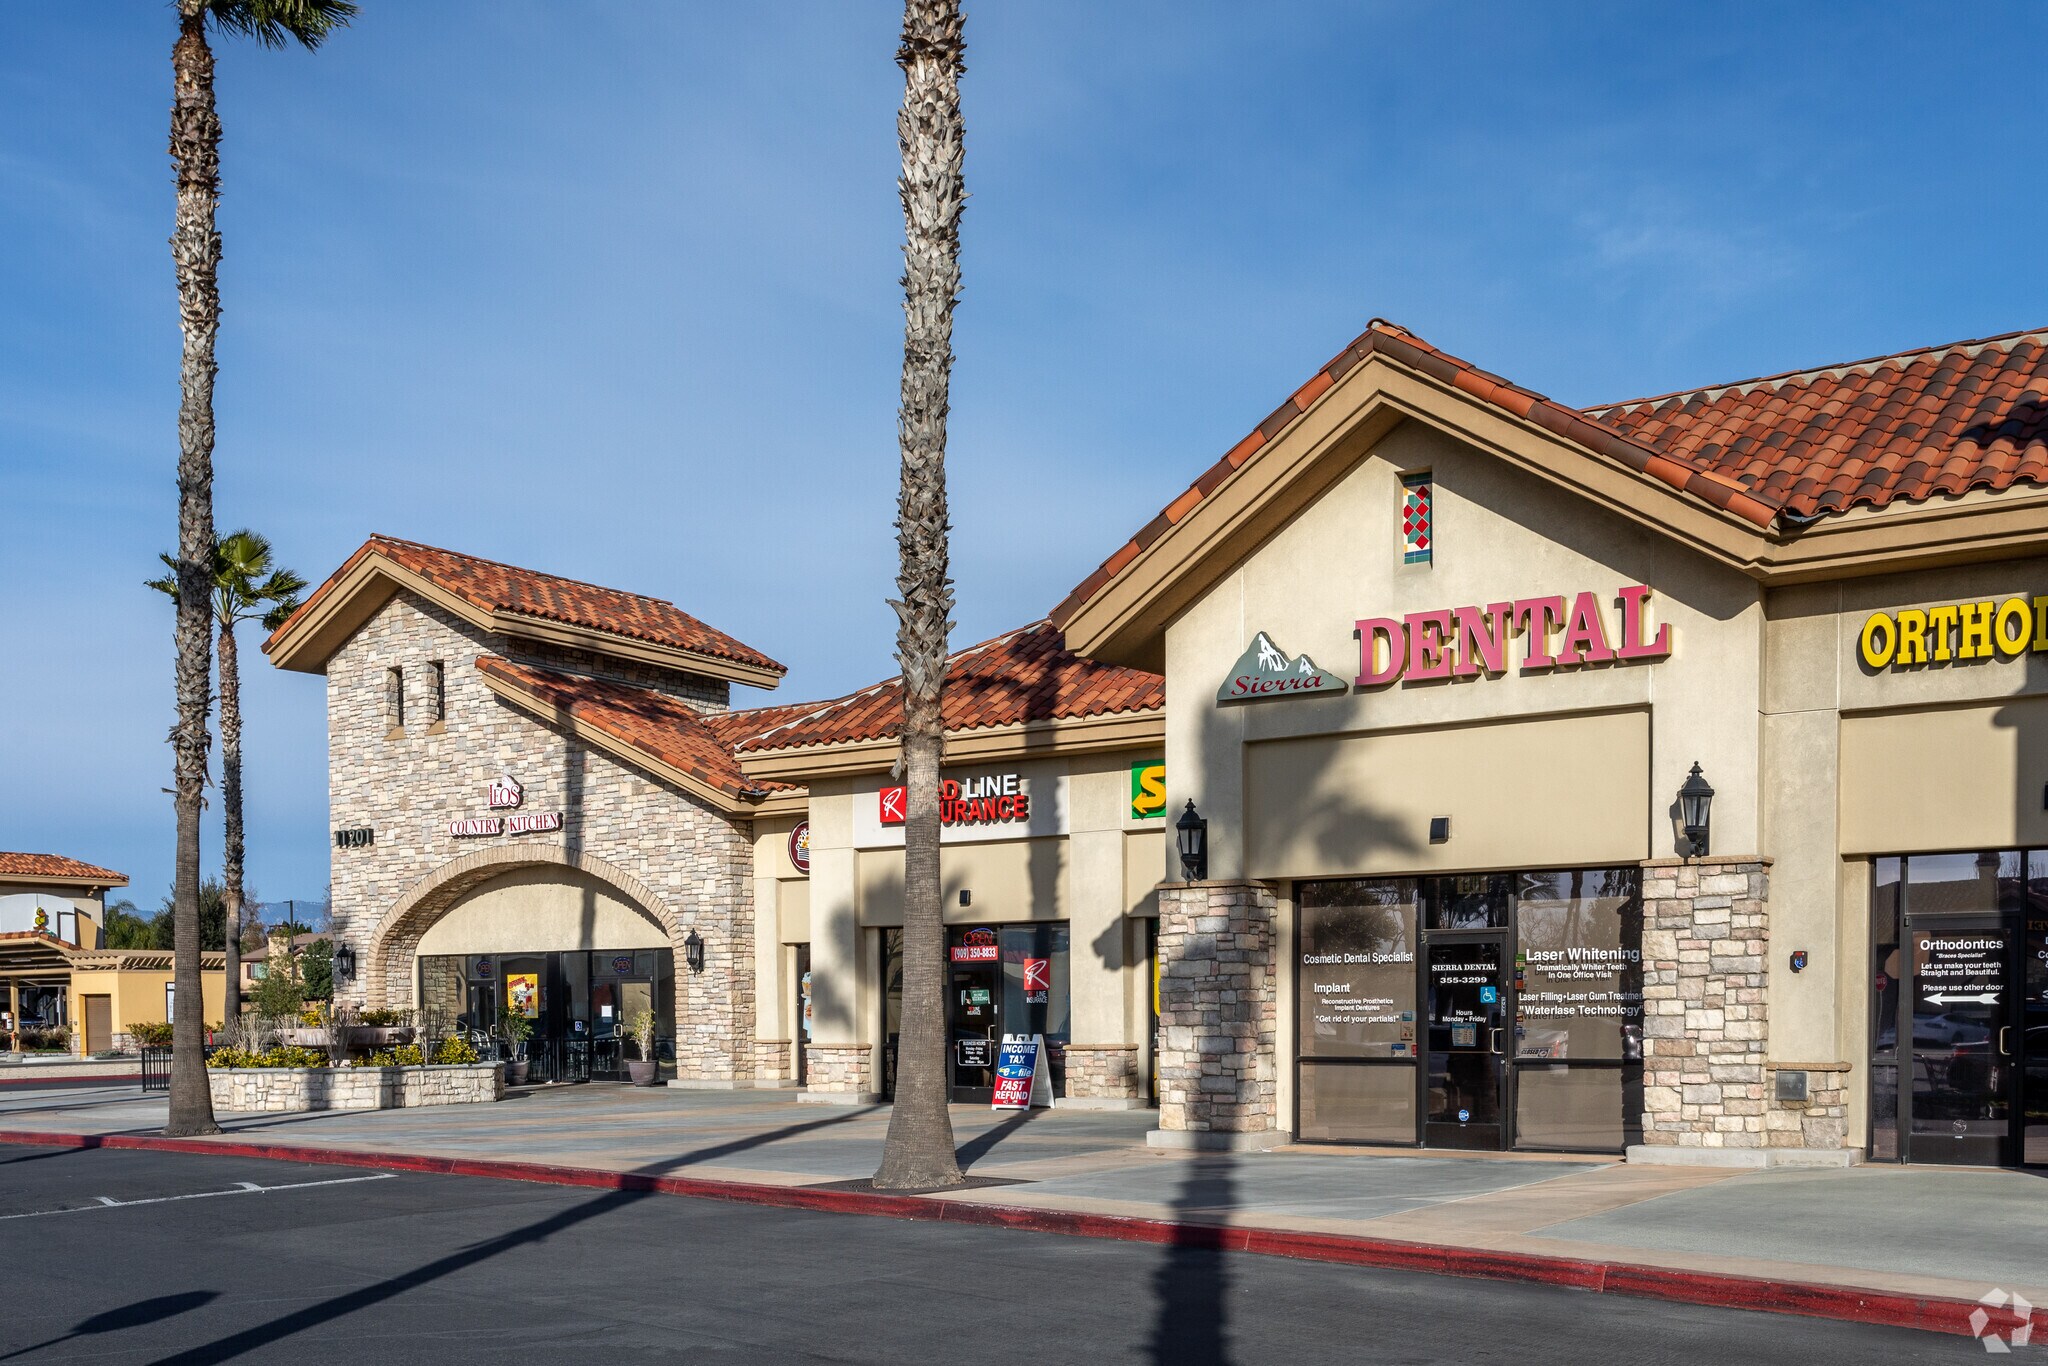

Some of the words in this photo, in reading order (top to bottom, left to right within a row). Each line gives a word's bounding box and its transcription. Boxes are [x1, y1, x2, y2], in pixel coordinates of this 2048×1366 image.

[1353, 585, 1671, 686] DENTAL
[1231, 673, 1325, 697] Sierra
[966, 773, 1018, 799] LINE
[941, 795, 1026, 823] URANCE
[450, 818, 500, 836] COUNTRY
[508, 813, 559, 832] KITCHEN
[335, 828, 371, 847] 11201
[963, 931, 993, 945] OPEN
[1920, 939, 2004, 950] Orthodontics
[954, 947, 969, 959] (909)
[970, 947, 996, 958] 350-8833
[1304, 954, 1341, 964] Cosmetic
[1344, 953, 1370, 963] Dental
[1372, 952, 1413, 964] Specialist
[1526, 948, 1564, 960] Laser
[1567, 947, 1640, 962] Whitening
[1537, 964, 1580, 972] Dramatically
[1921, 969, 1949, 977] Straight
[1440, 976, 1487, 984] 355-3299
[1314, 983, 1350, 994] Implant
[1519, 993, 1539, 1001] Laser
[1589, 992, 1606, 1000] Gum
[1520, 1006, 1575, 1015] "Waterlase
[1578, 1005, 1643, 1016] Technology"
[1369, 1015, 1399, 1023] partials!"
[1003, 1045, 1036, 1054] INCOME
[1009, 1055, 1026, 1064] TAX
[1000, 1081, 1025, 1091] FAST
[995, 1091, 1028, 1100] REFUND
